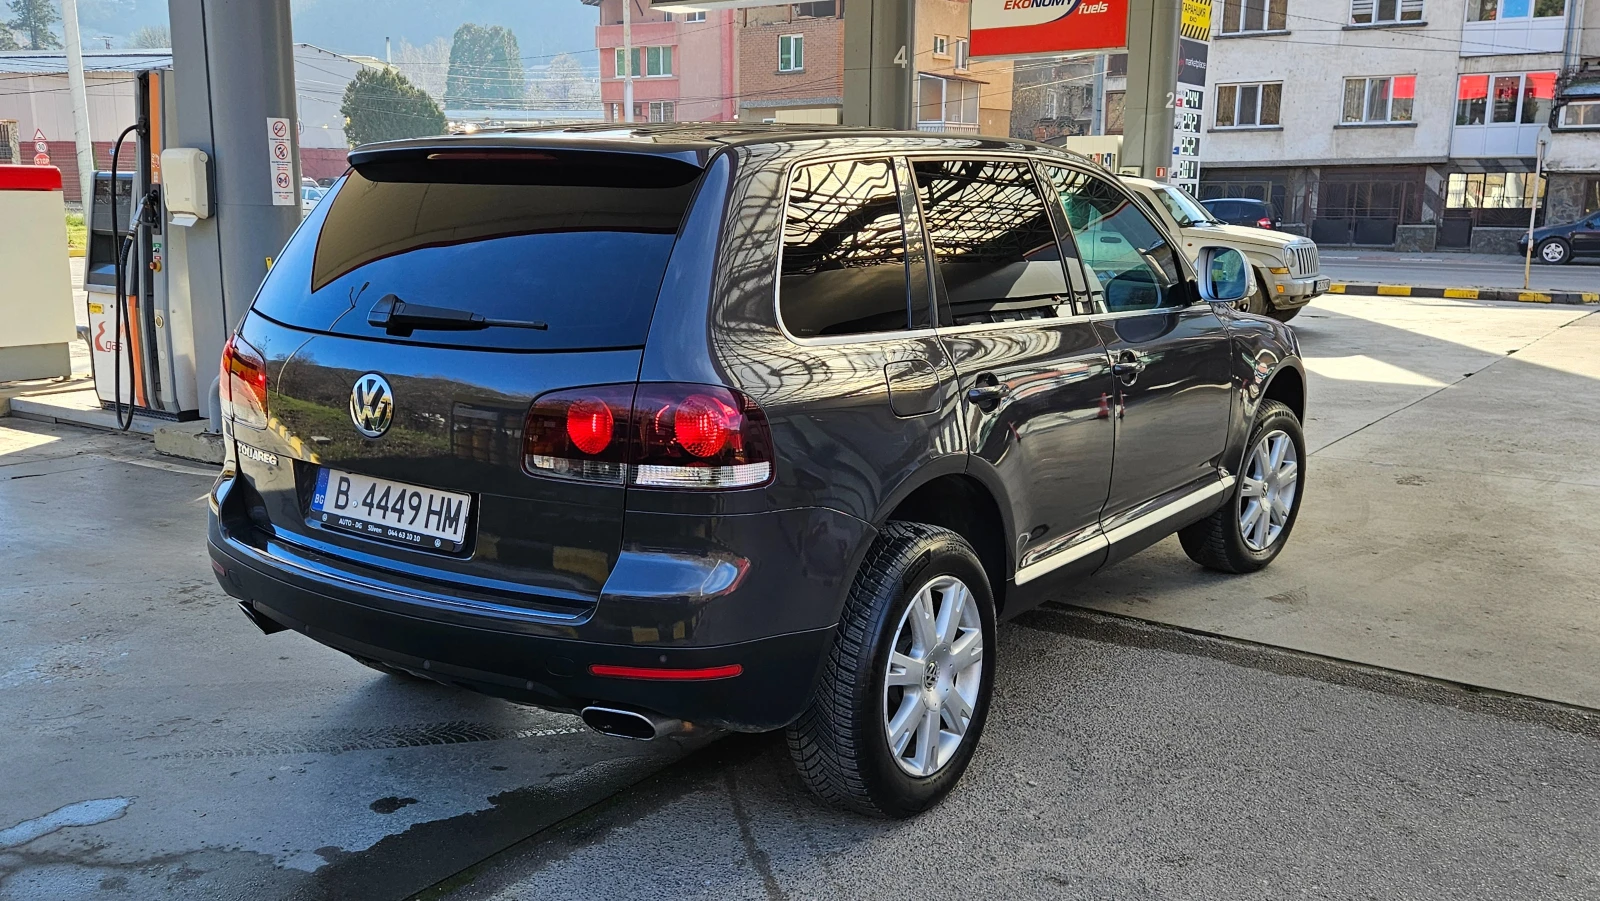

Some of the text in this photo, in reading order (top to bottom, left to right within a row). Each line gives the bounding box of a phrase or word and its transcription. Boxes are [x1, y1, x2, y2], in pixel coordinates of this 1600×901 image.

[1078, 3, 1109, 14] fuels
[894, 46, 907, 68] 4
[1165, 92, 1174, 108] 2
[314, 493, 325, 504] BG
[361, 482, 422, 526] 4449
[424, 494, 463, 535] HM
